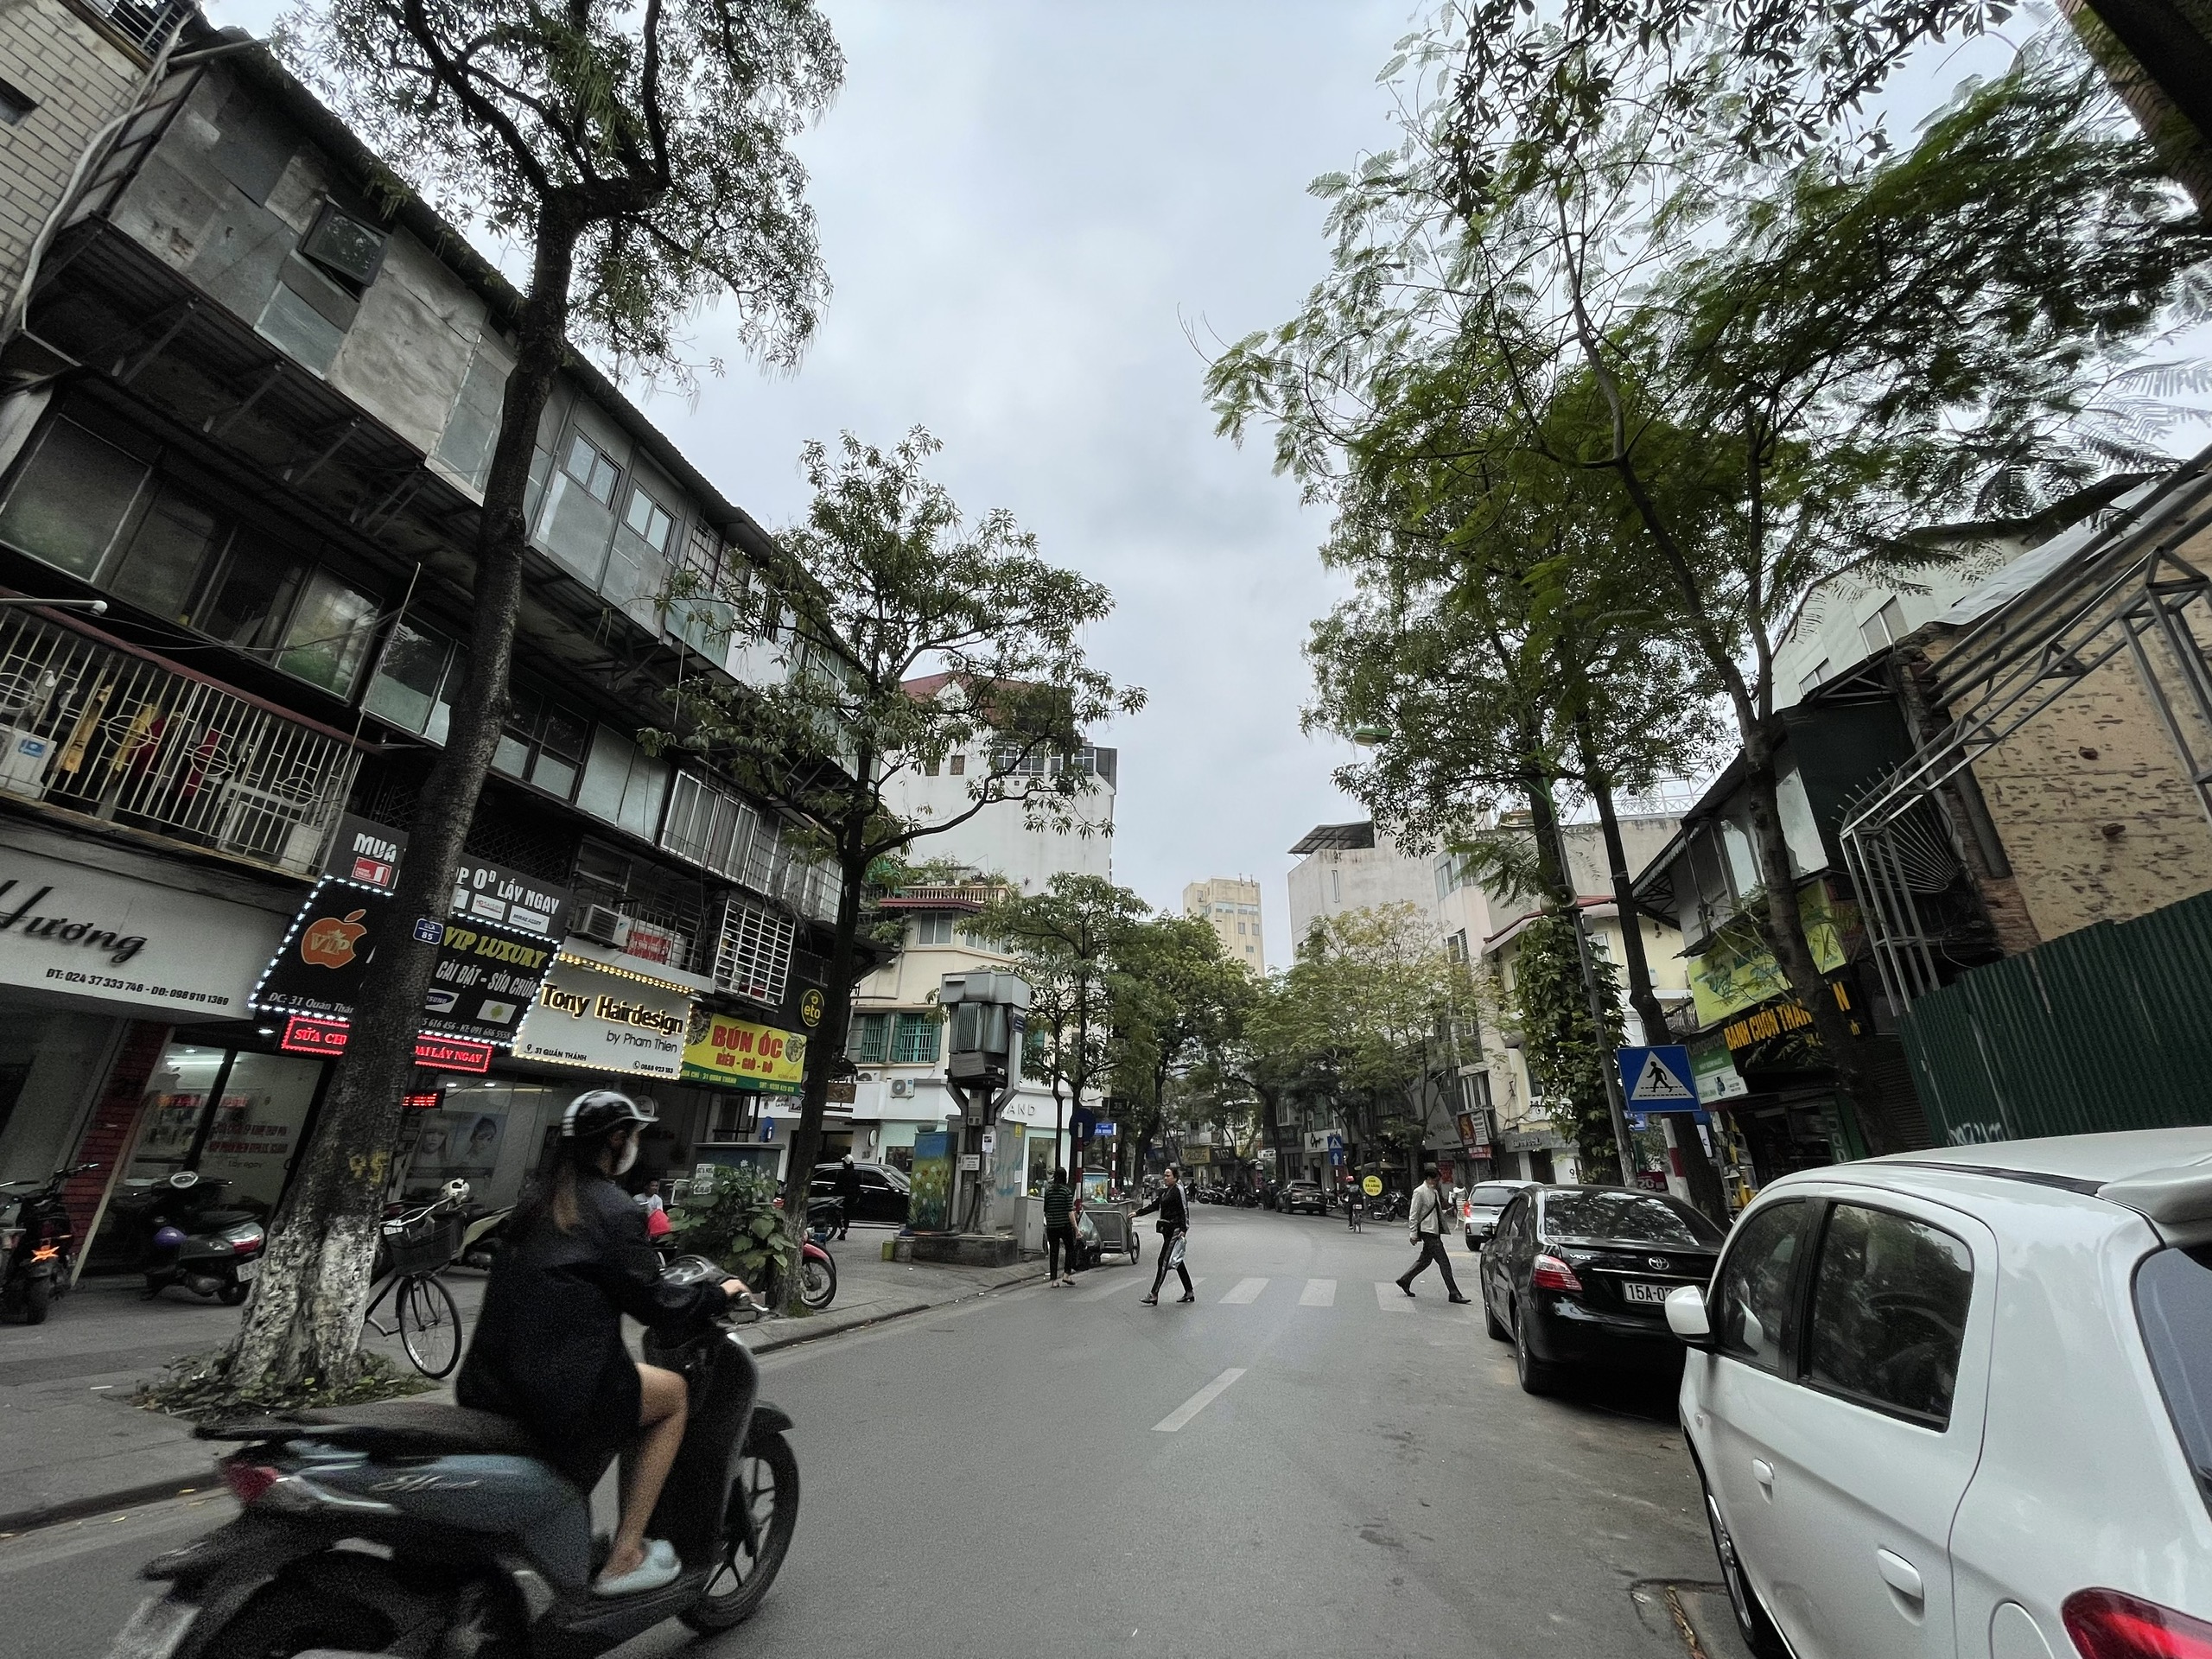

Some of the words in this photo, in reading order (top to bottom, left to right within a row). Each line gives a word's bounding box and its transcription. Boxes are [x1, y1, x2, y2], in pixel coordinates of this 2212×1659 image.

[353, 833, 397, 862] MUA
[497, 878, 524, 902] LẤY
[524, 890, 560, 915] NGAY
[311, 932, 351, 956] VIP
[422, 932, 433, 941] 85
[444, 926, 477, 950] VIP
[474, 936, 548, 969] LUXURY
[65, 971, 86, 983] 024
[88, 975, 103, 987] 37
[103, 977, 124, 989] 333
[125, 982, 143, 993] 746
[169, 988, 188, 1000] 098
[456, 964, 482, 988] ĐẶT
[269, 993, 287, 1003] ĐC:
[289, 995, 304, 1006] 31
[540, 983, 590, 1019] Tony
[594, 995, 683, 1037] Hairdesign
[804, 1004, 821, 1020] eto
[607, 1030, 620, 1046] by
[623, 1033, 652, 1049] Pham
[654, 1039, 677, 1053] Thien
[711, 1026, 754, 1052] BÚN
[454, 1051, 484, 1064] NGAY
[543, 1048, 563, 1058] QUÁN
[564, 1050, 588, 1062] THÁNH
[1568, 1168, 1575, 1177] 9
